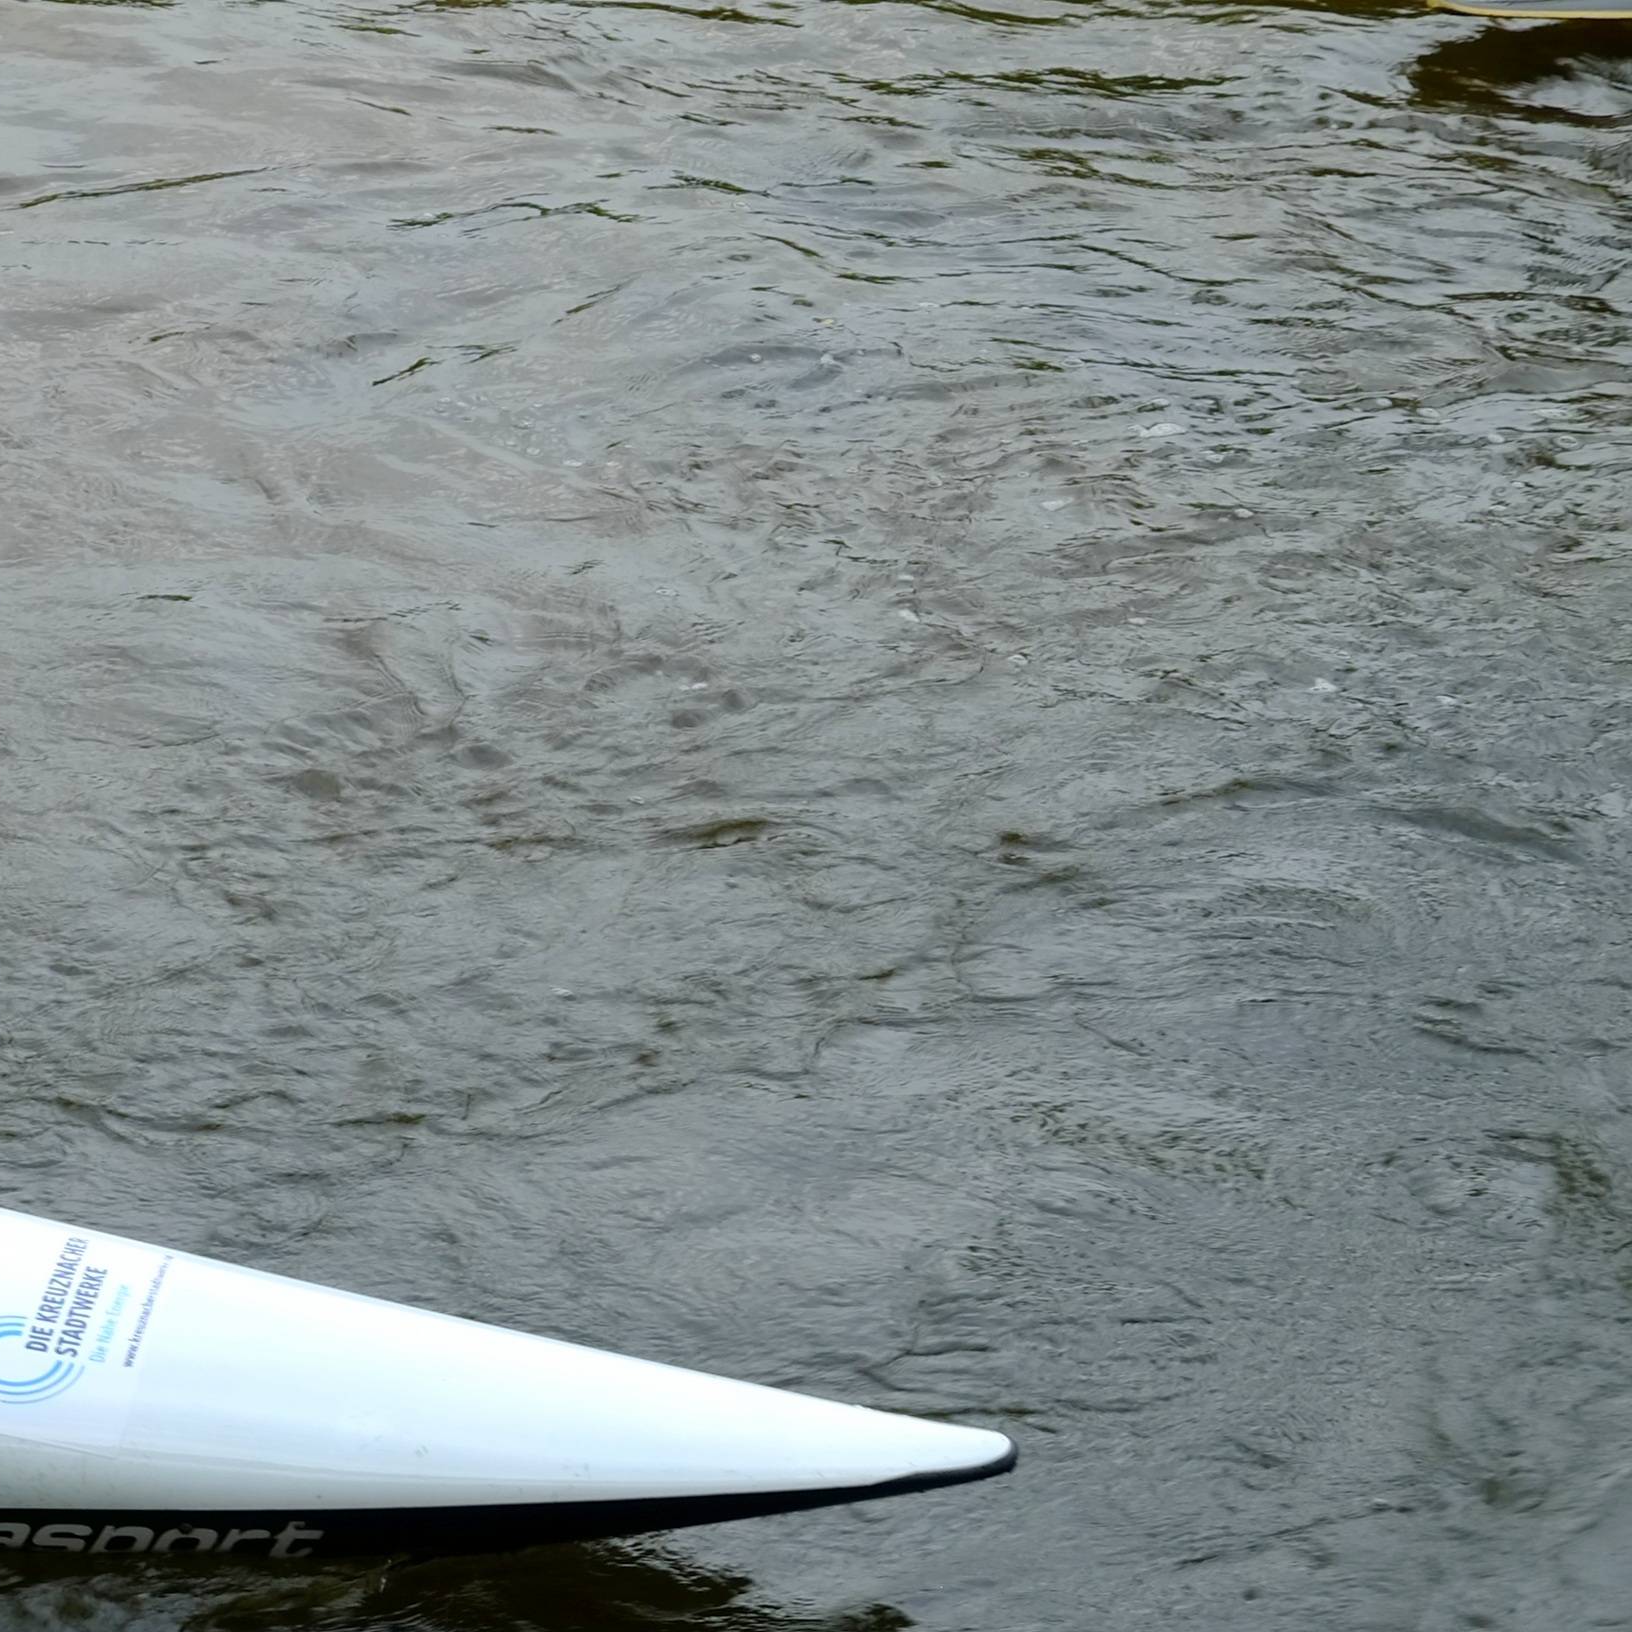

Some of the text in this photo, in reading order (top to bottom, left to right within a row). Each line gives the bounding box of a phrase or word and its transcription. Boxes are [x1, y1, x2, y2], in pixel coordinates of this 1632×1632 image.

[25, 1236, 89, 1353] DIE KREUZNACHER
[54, 1265, 108, 1358] STADTWERKE
